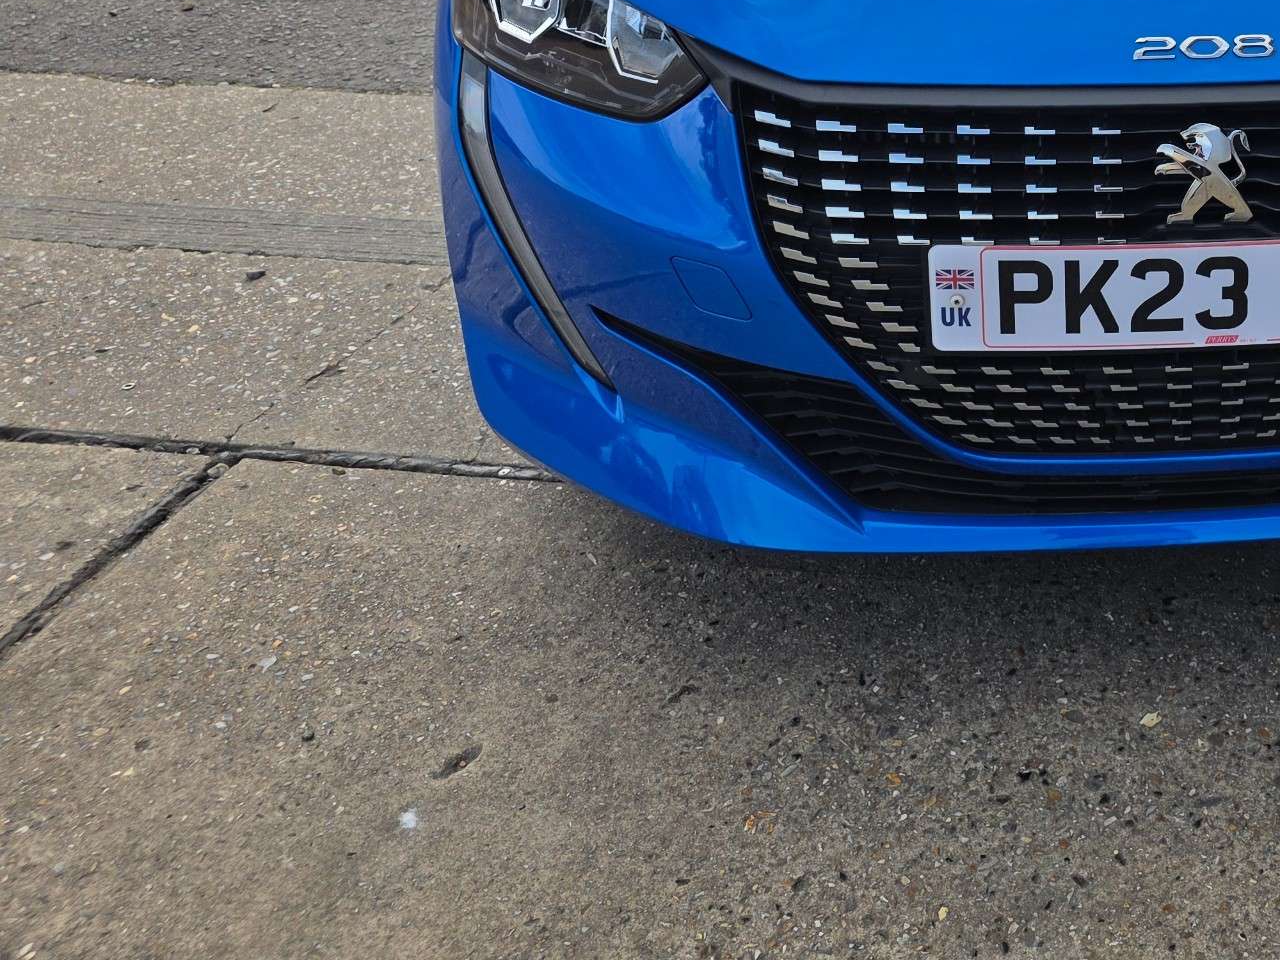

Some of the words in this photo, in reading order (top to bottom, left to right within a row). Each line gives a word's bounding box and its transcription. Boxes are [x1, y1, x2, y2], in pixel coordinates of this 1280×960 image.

[1133, 34, 1274, 60] 208
[997, 256, 1250, 335] PK23
[941, 306, 972, 327] UK
